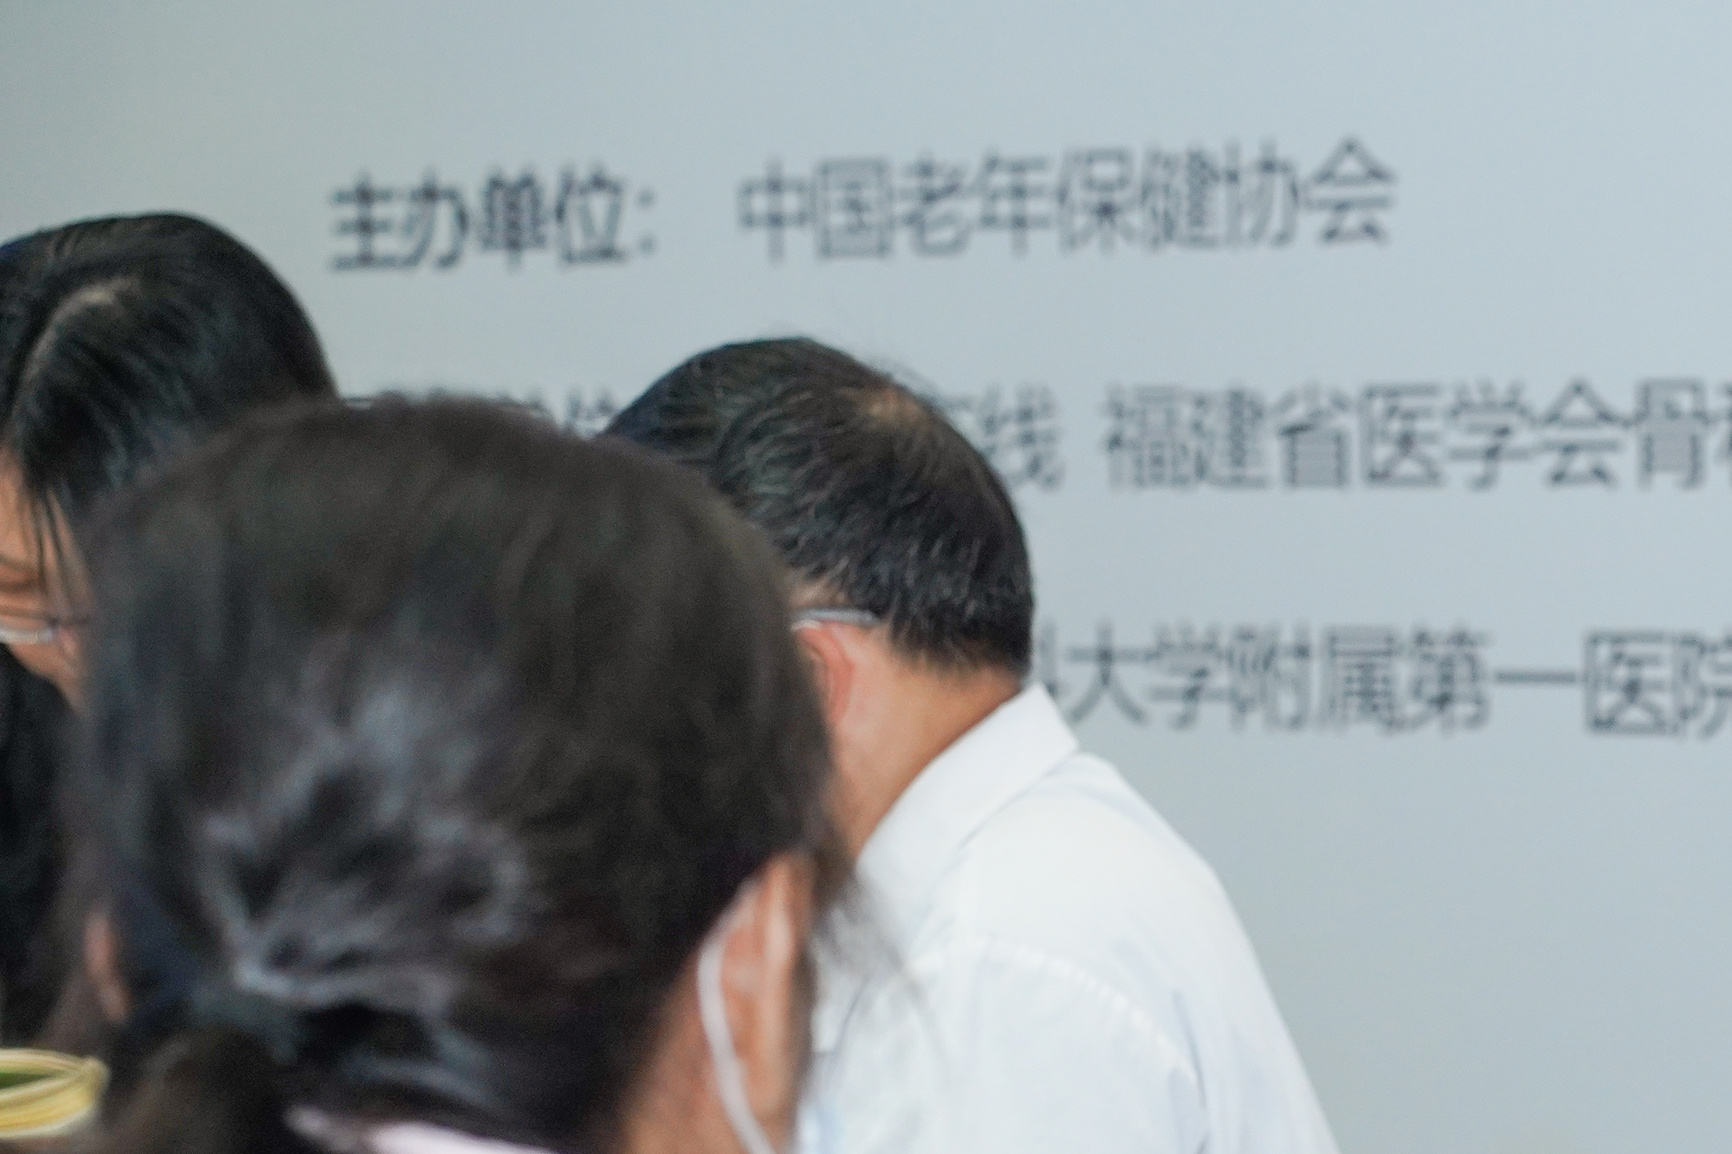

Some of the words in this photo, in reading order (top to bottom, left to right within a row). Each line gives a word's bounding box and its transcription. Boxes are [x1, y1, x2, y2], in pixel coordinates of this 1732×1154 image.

[736, 136, 1394, 262] 中国老年保健协会
